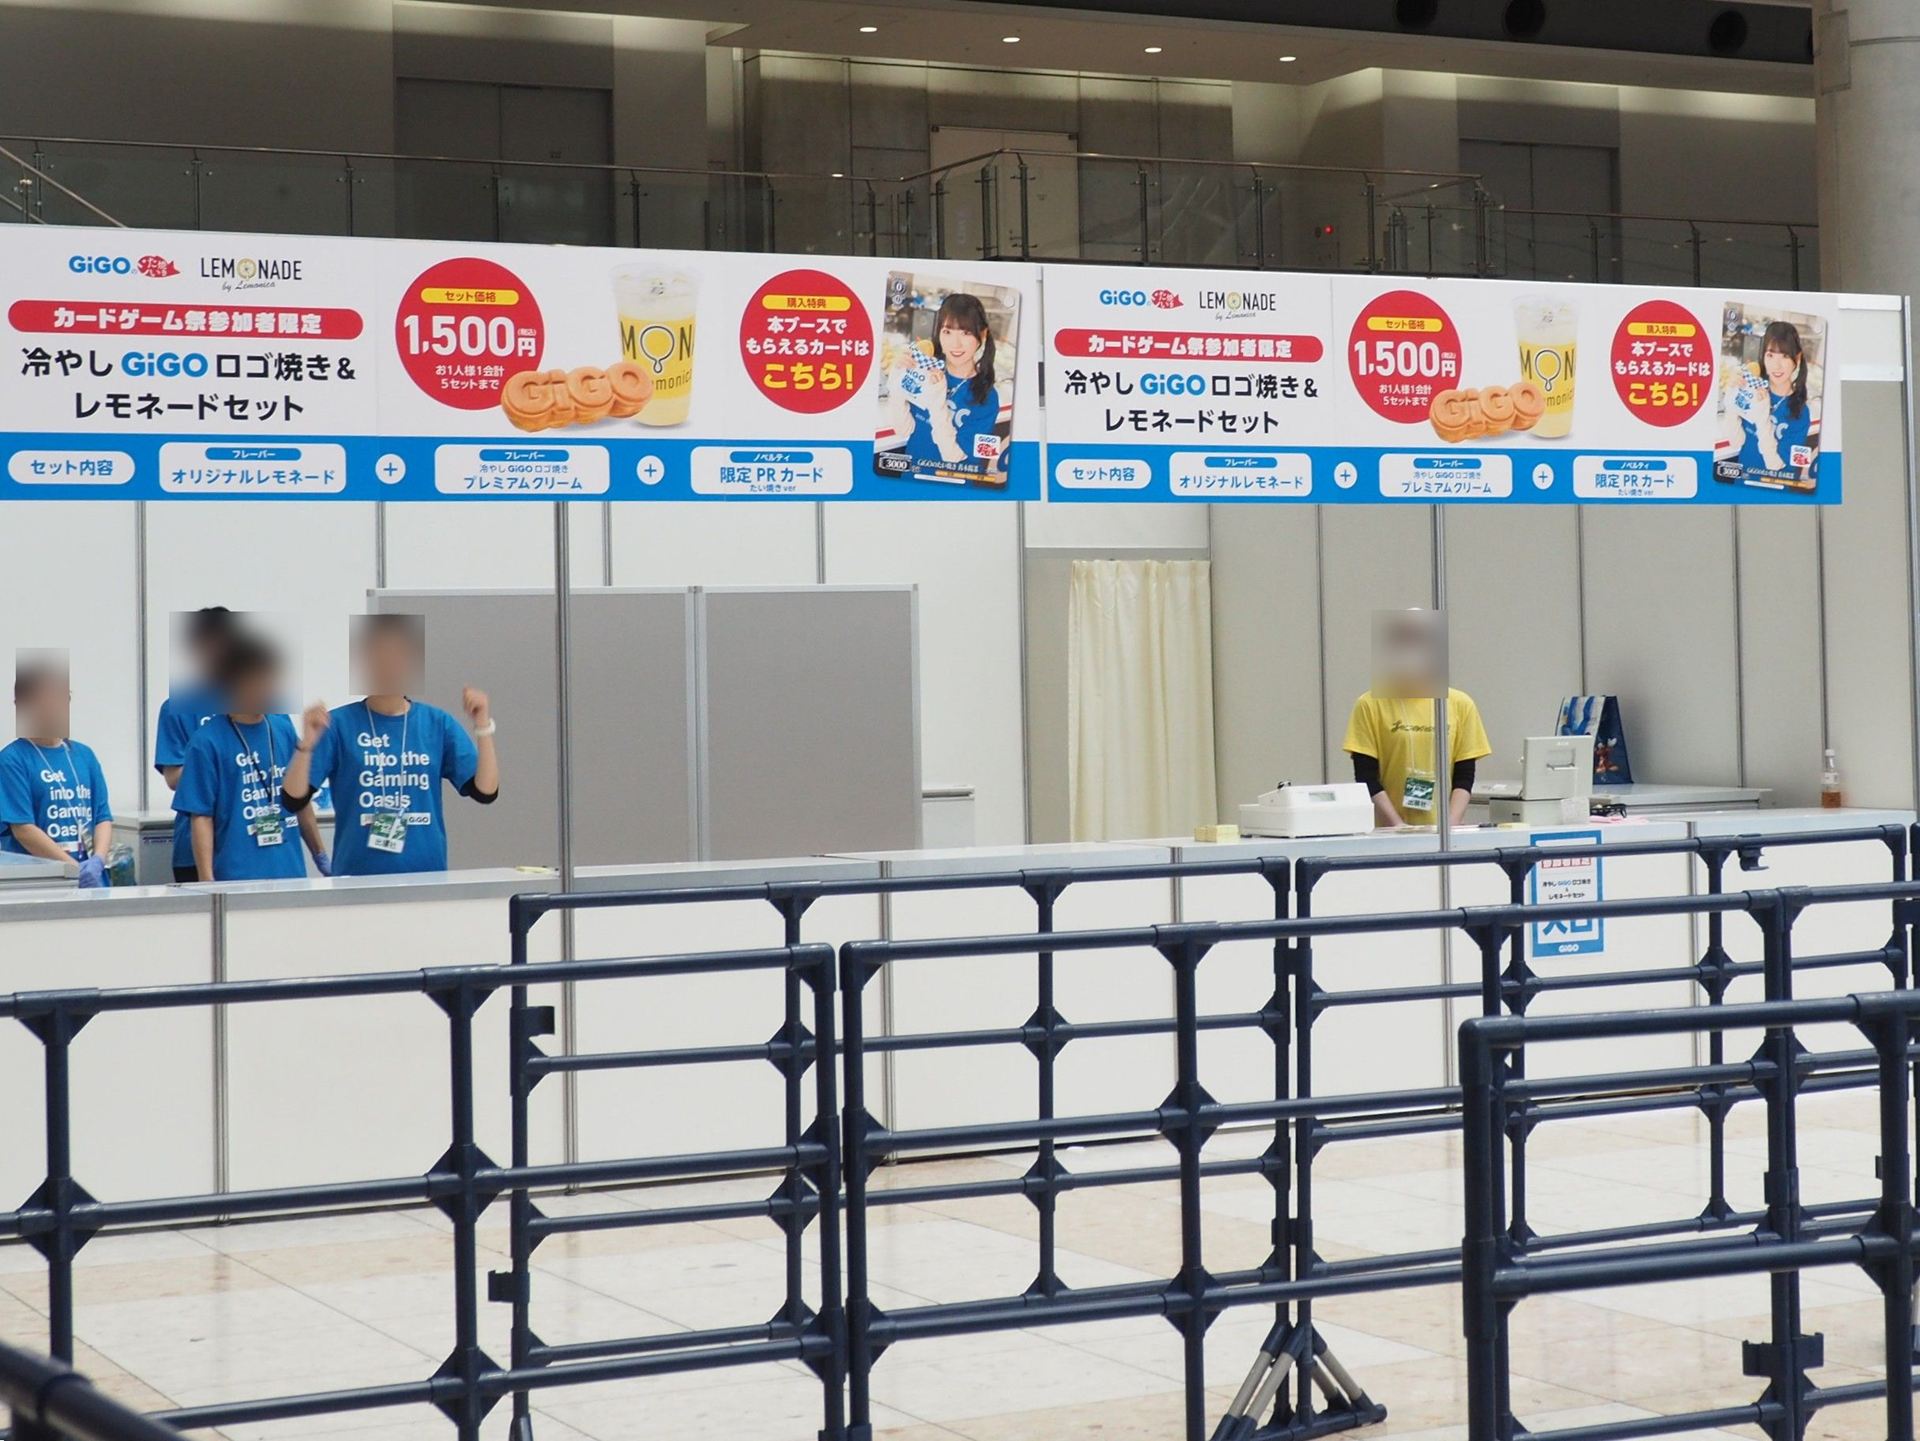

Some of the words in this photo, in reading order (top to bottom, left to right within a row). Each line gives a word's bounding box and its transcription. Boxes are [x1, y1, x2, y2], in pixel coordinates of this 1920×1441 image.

[69, 255, 131, 275] GiGO
[201, 257, 302, 280] LEMONADE
[222, 282, 232, 292] by
[445, 290, 497, 302] セット価格
[786, 297, 827, 309] 購入特典
[1099, 289, 1146, 306] GiGO
[1199, 291, 1277, 311] LEMONADE
[54, 307, 322, 335] カードゲーム祭参加者限定
[766, 317, 848, 335] 本ブースで
[1385, 319, 1425, 330] セット価格
[745, 338, 870, 357] もらえるカードは
[1088, 335, 1293, 358] カードゲーム祭参加者限定
[1631, 342, 1693, 357] 本ブースで
[21, 346, 114, 378] 冷やし
[121, 351, 209, 378] GiGO
[1615, 361, 1711, 377] もらえるカードは
[435, 365, 505, 377] お1人様1会計
[763, 362, 854, 391] こちら!
[441, 378, 500, 390] 5セットまで
[1064, 369, 1134, 396] 冷やし
[1140, 373, 1206, 396] GiGO
[1383, 396, 1429, 406] 5セットまで
[1628, 382, 1699, 408] こちら!
[75, 392, 304, 422] レモネードセット
[1105, 409, 1279, 434] レモネードセット
[231, 449, 276, 459] フレーバー
[504, 451, 545, 460] フレーバー
[753, 452, 791, 462] ノベルティ
[1224, 458, 1258, 466] フレーバー
[31, 459, 114, 476] セット内容
[508, 464, 533, 473] GiGO
[886, 459, 908, 470] 3000
[1431, 459, 1464, 468] フレーバー
[1620, 461, 1650, 470] ノベルティ
[171, 469, 336, 486] オリジナルレモネード
[720, 466, 752, 483] 限定
[756, 467, 776, 482] PR
[781, 467, 824, 483] カード
[1072, 467, 1135, 481] セット内容
[1179, 474, 1304, 489] オリジナルレモネード
[1594, 473, 1620, 489] 限定
[1623, 474, 1639, 488] PR
[1642, 474, 1675, 489] カード
[463, 476, 583, 490] プレミアムクリーム
[1401, 482, 1492, 494] プレミアムクリーム
[357, 732, 390, 748] Get
[235, 751, 260, 767] Get
[364, 751, 398, 767] into
[401, 751, 430, 766] the
[40, 769, 67, 783] Get
[242, 769, 268, 785] into
[359, 770, 430, 791] Gaming
[50, 786, 75, 801] into
[76, 784, 92, 799] the
[359, 791, 412, 809] Oasis
[47, 804, 93, 822] Gaming
